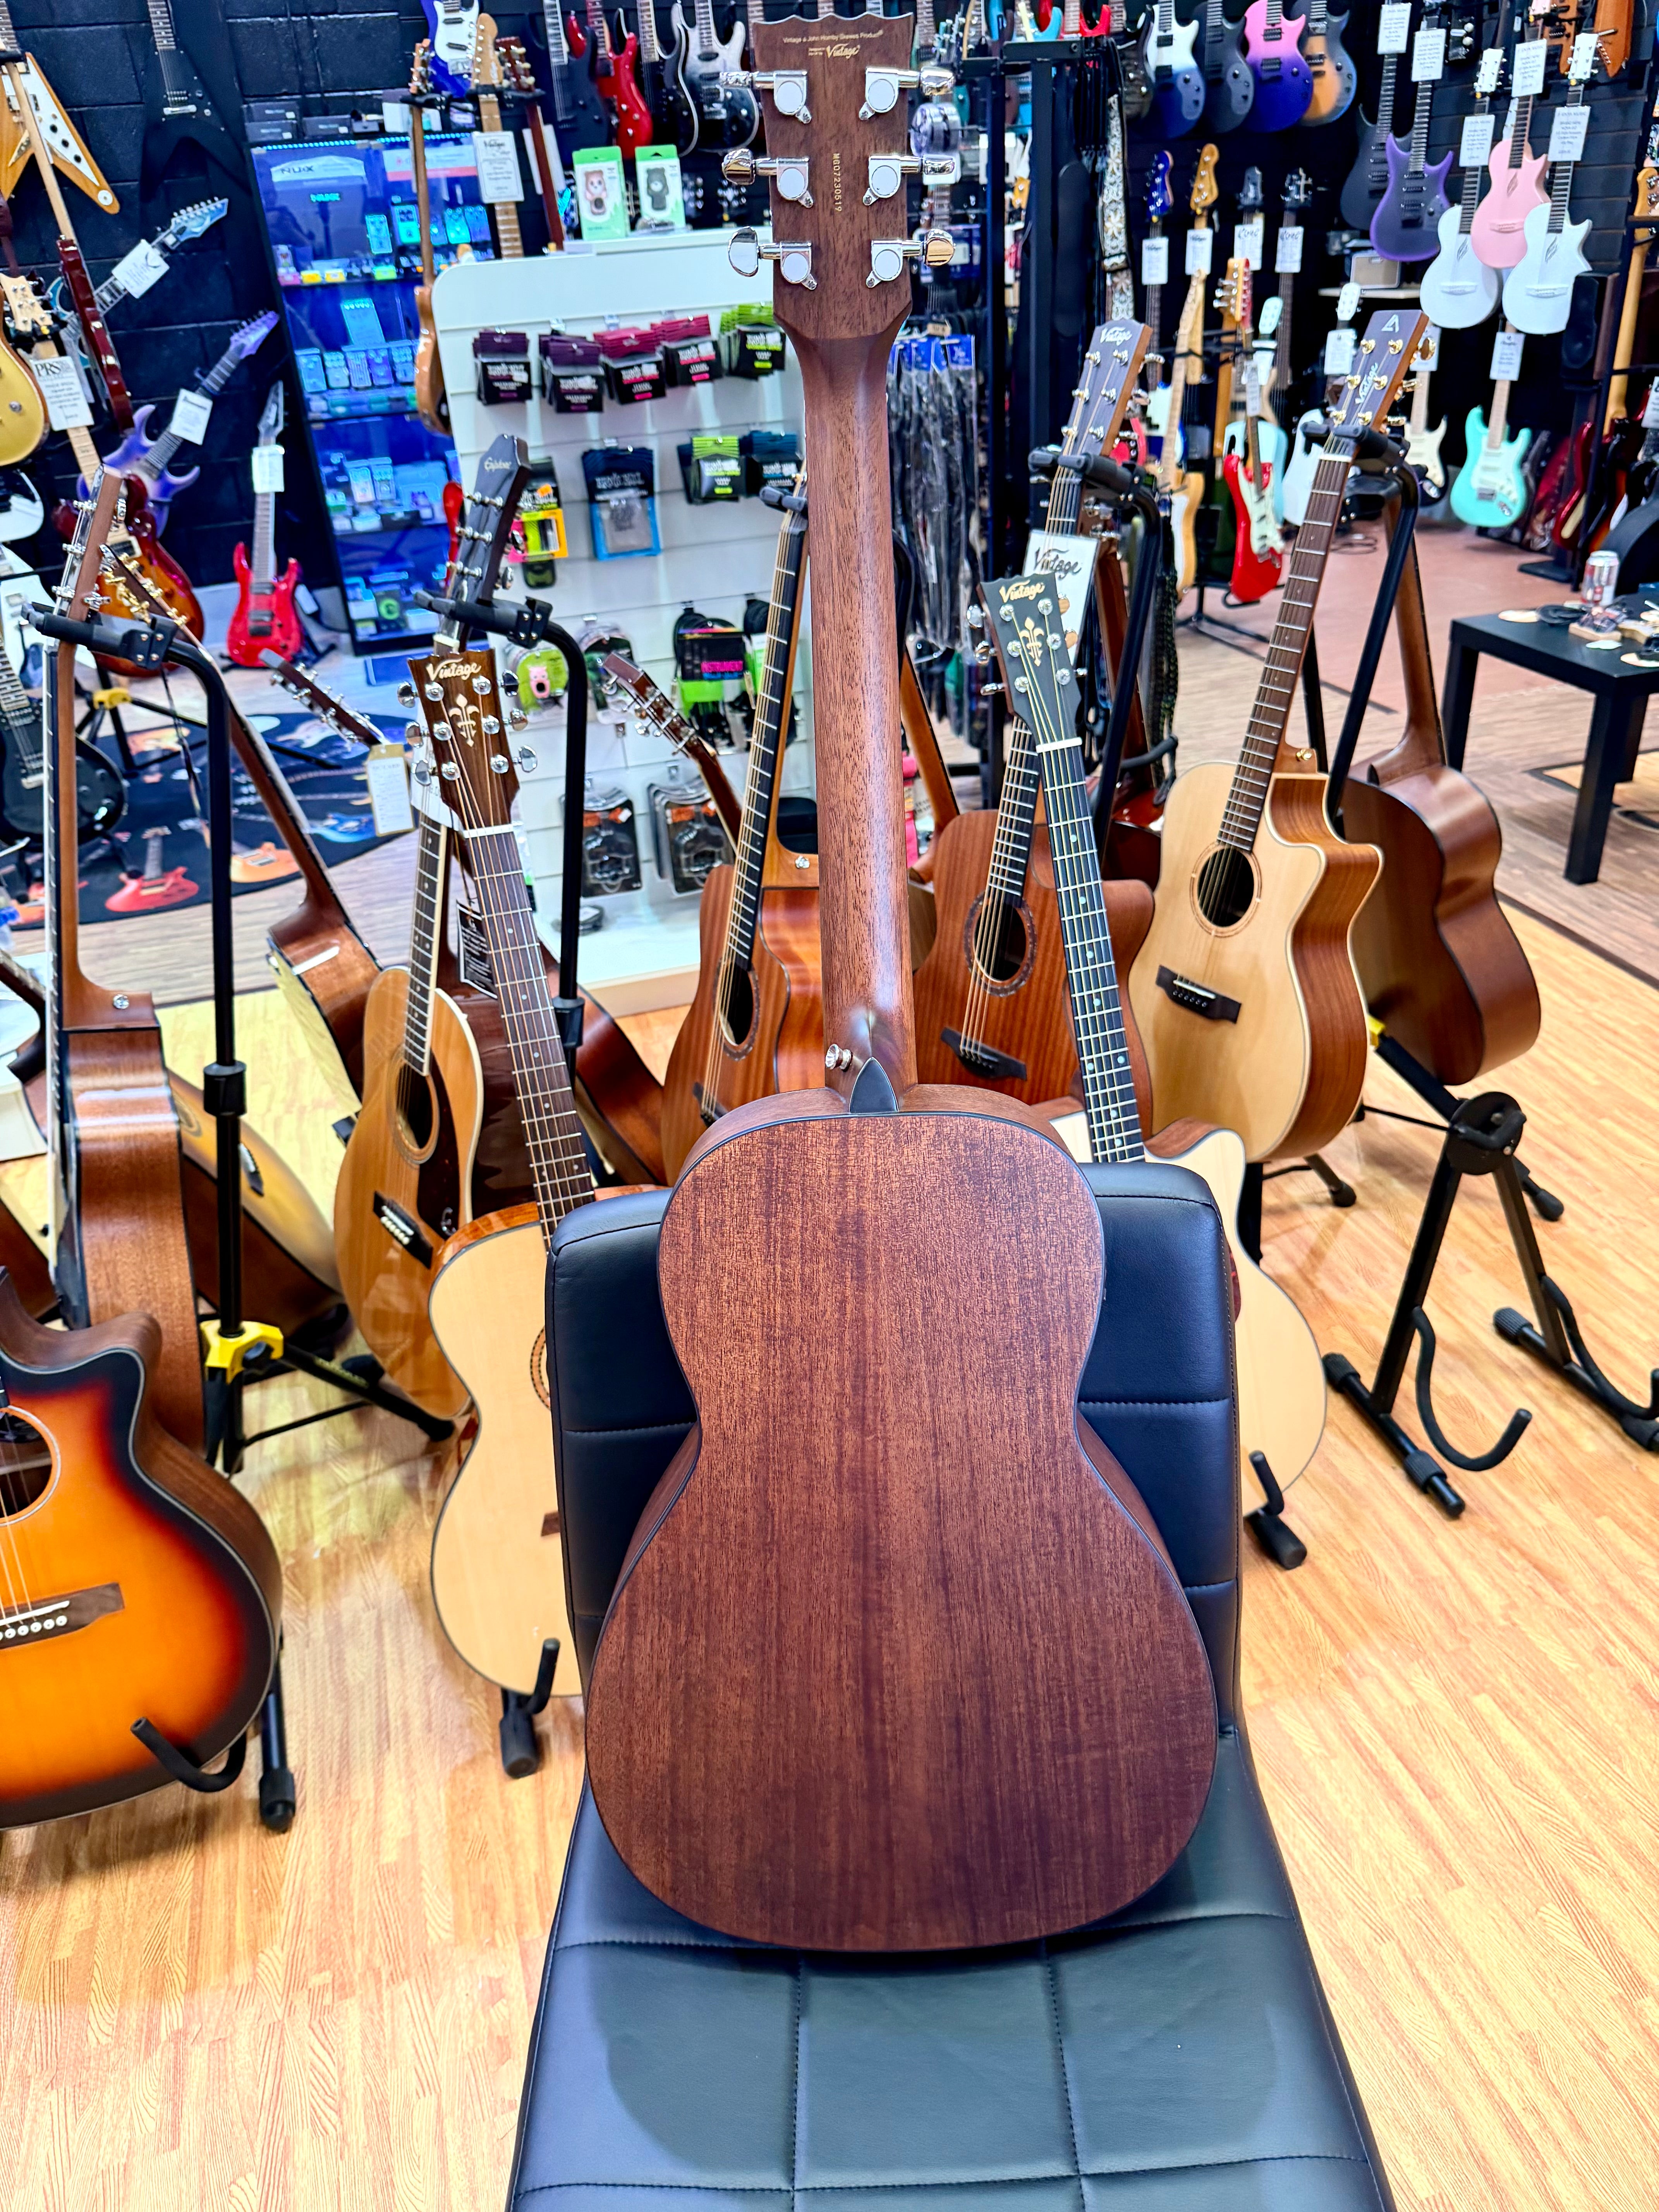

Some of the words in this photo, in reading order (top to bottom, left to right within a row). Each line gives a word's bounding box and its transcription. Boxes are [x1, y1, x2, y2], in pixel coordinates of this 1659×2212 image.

[826, 43, 860, 59] Vintage
[35, 362, 62, 377] PRS
[1355, 362, 1379, 404] Vintage
[1034, 546, 1082, 580] Vintage
[999, 579, 1046, 603] Vintage
[426, 658, 481, 681] Vintage
